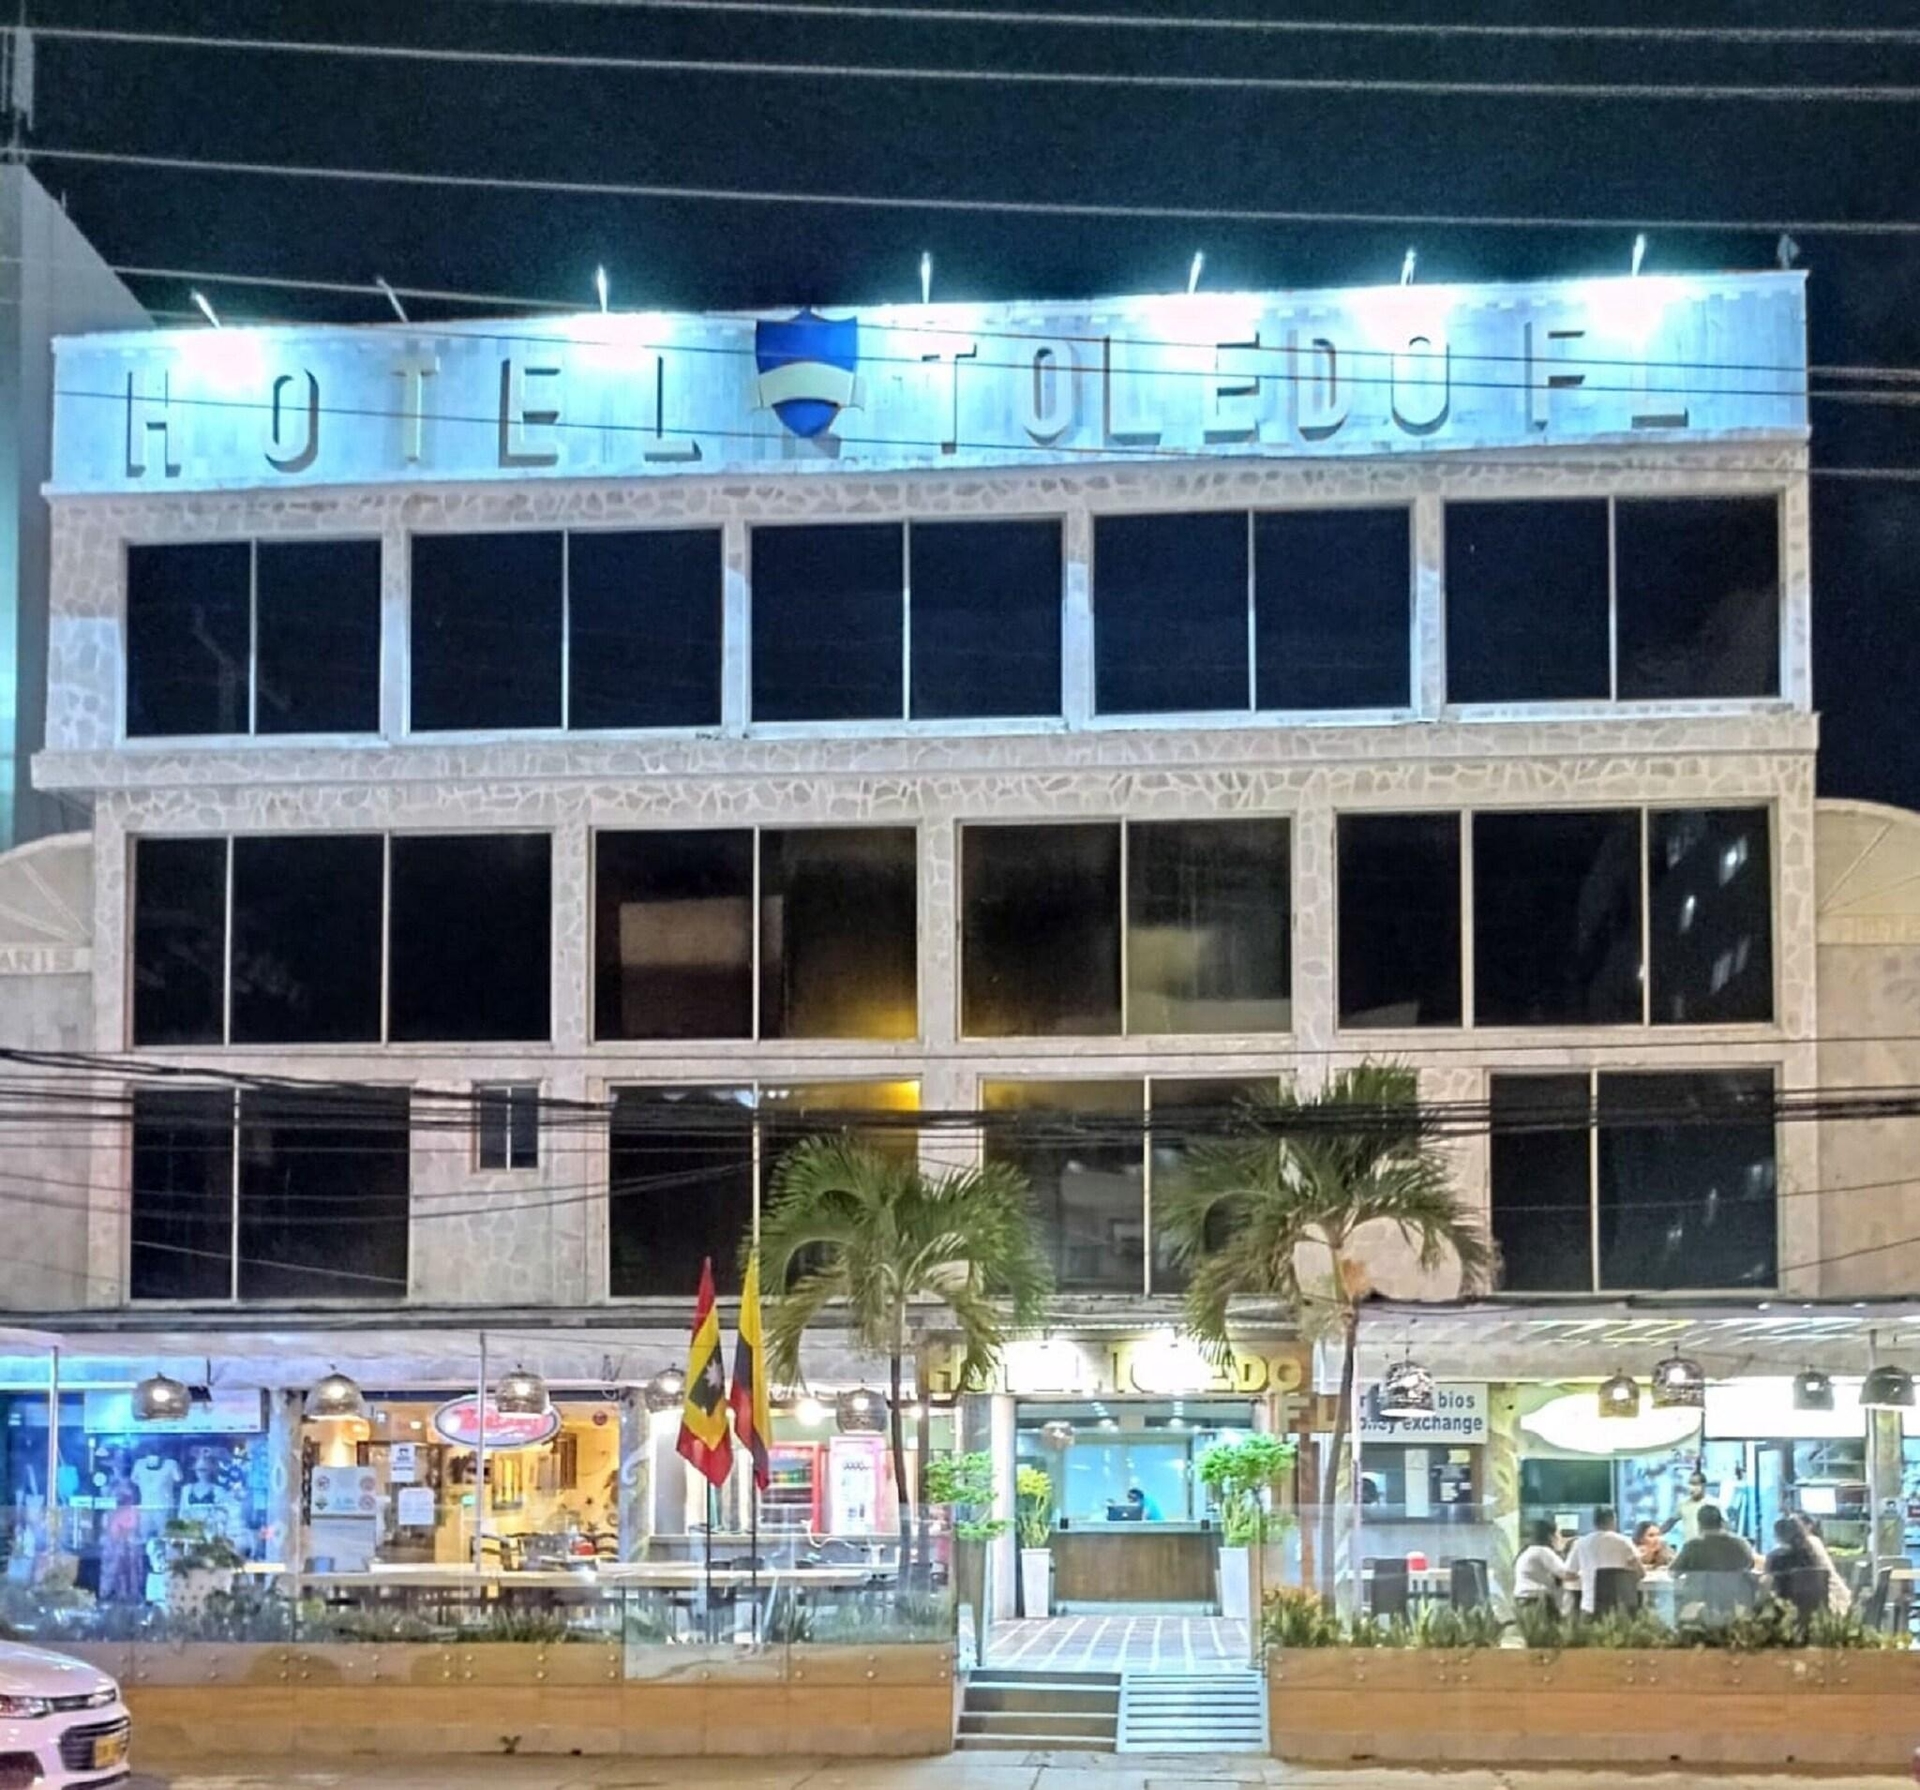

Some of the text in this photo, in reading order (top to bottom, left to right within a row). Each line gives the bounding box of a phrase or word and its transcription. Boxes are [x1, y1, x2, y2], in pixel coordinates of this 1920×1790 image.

[126, 352, 702, 478] HOTEL
[921, 326, 1450, 455] TOLEDO
[1360, 1415, 1483, 1434] oney exchange
